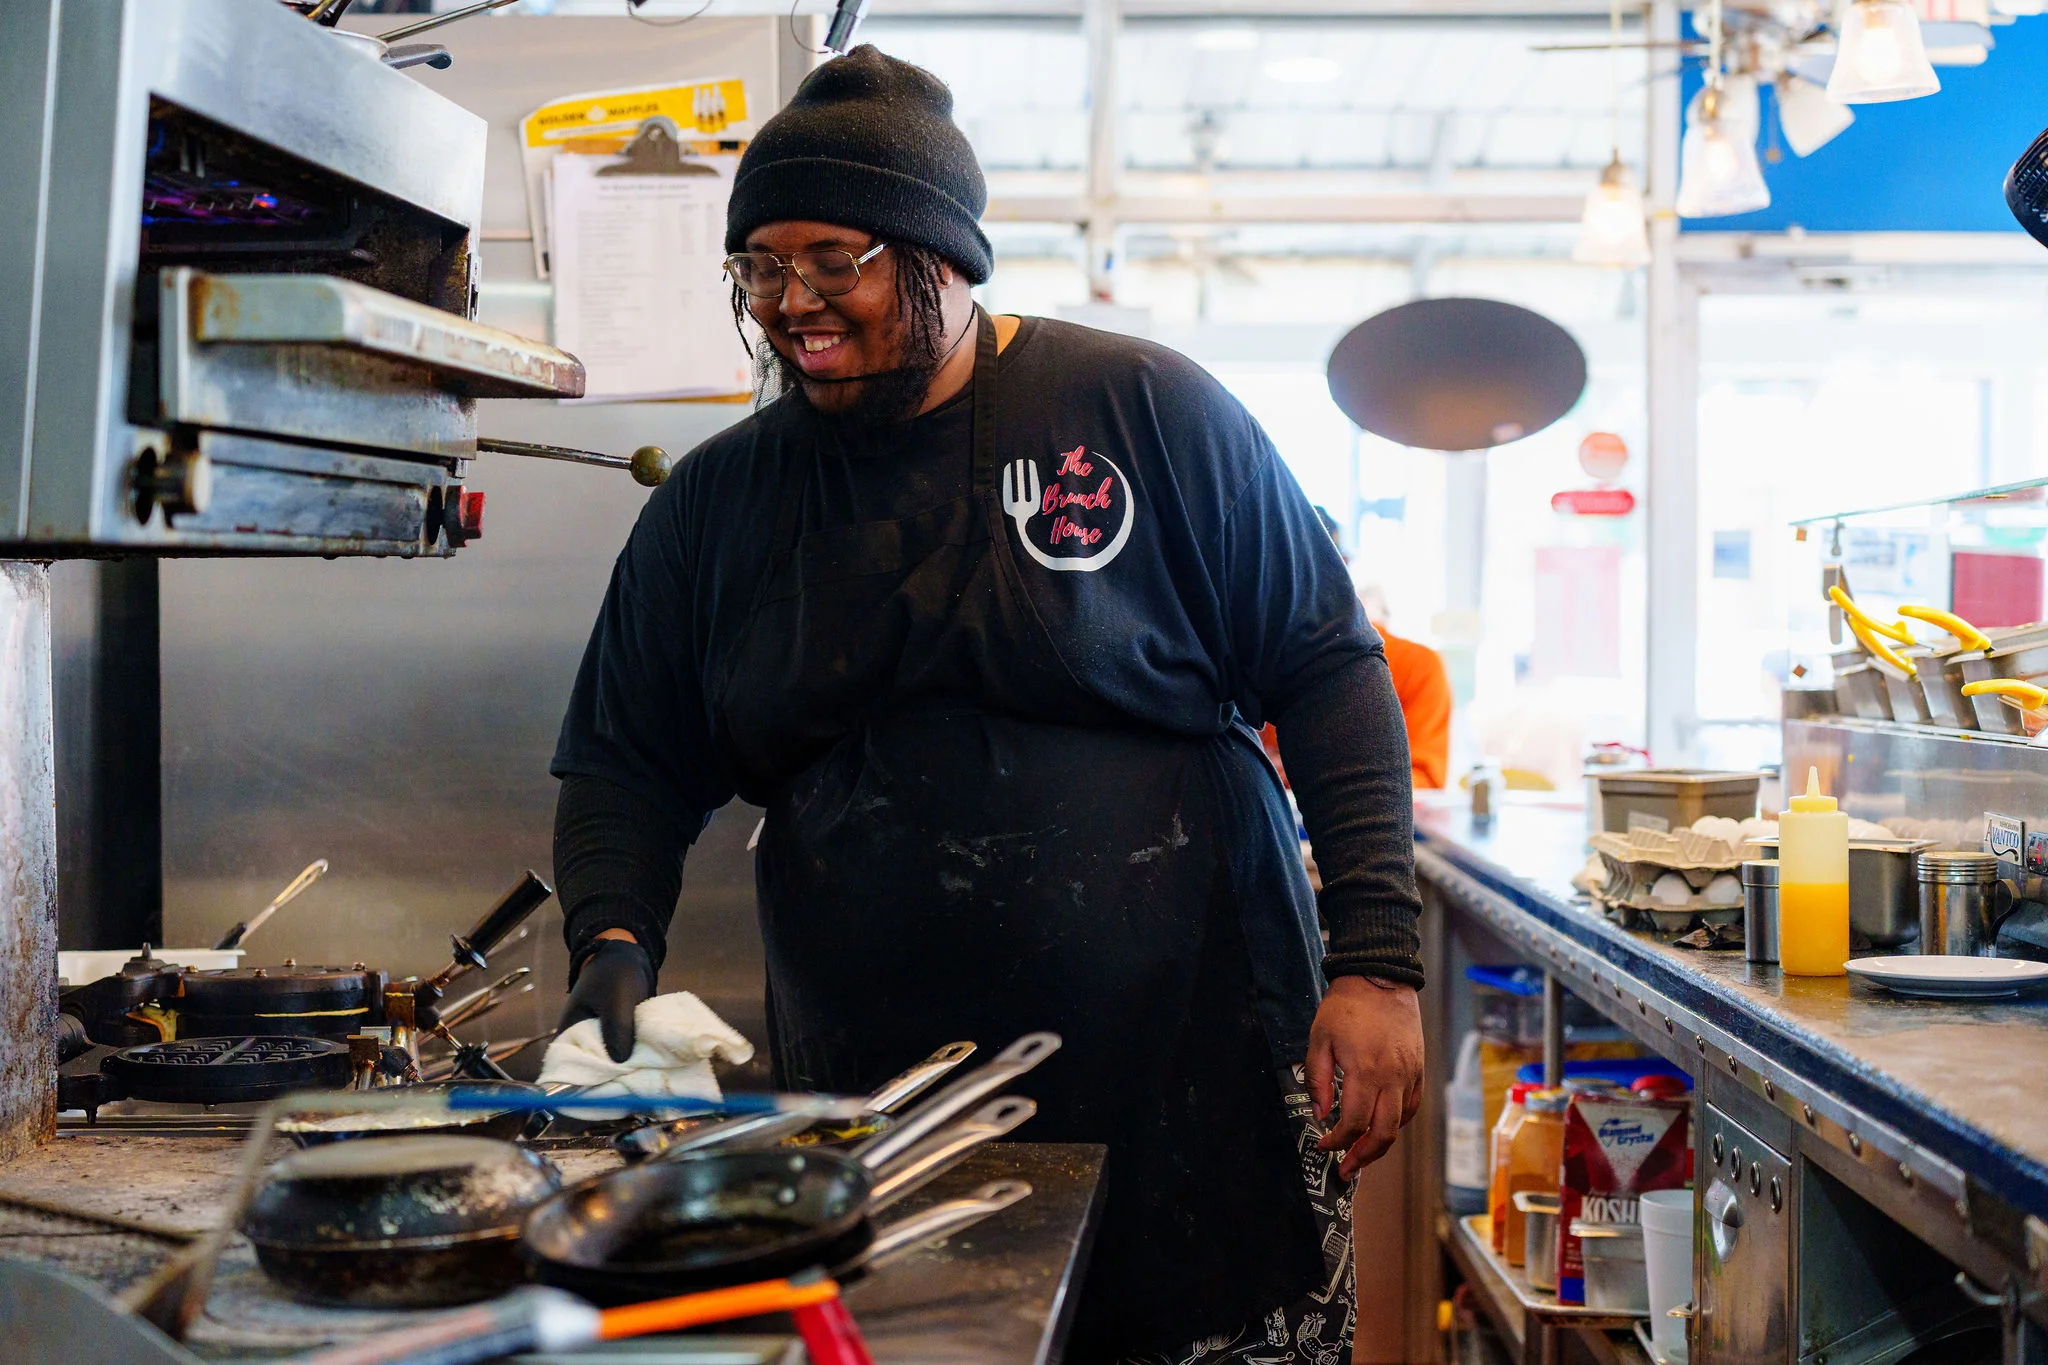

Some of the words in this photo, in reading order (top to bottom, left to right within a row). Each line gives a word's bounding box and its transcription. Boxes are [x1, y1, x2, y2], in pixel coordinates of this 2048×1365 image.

[1057, 444, 1094, 477] The
[1042, 476, 1113, 516] Brunch
[1050, 515, 1103, 546] House
[1598, 1124, 1642, 1138] Diamond
[1617, 1131, 1655, 1146] Crystal
